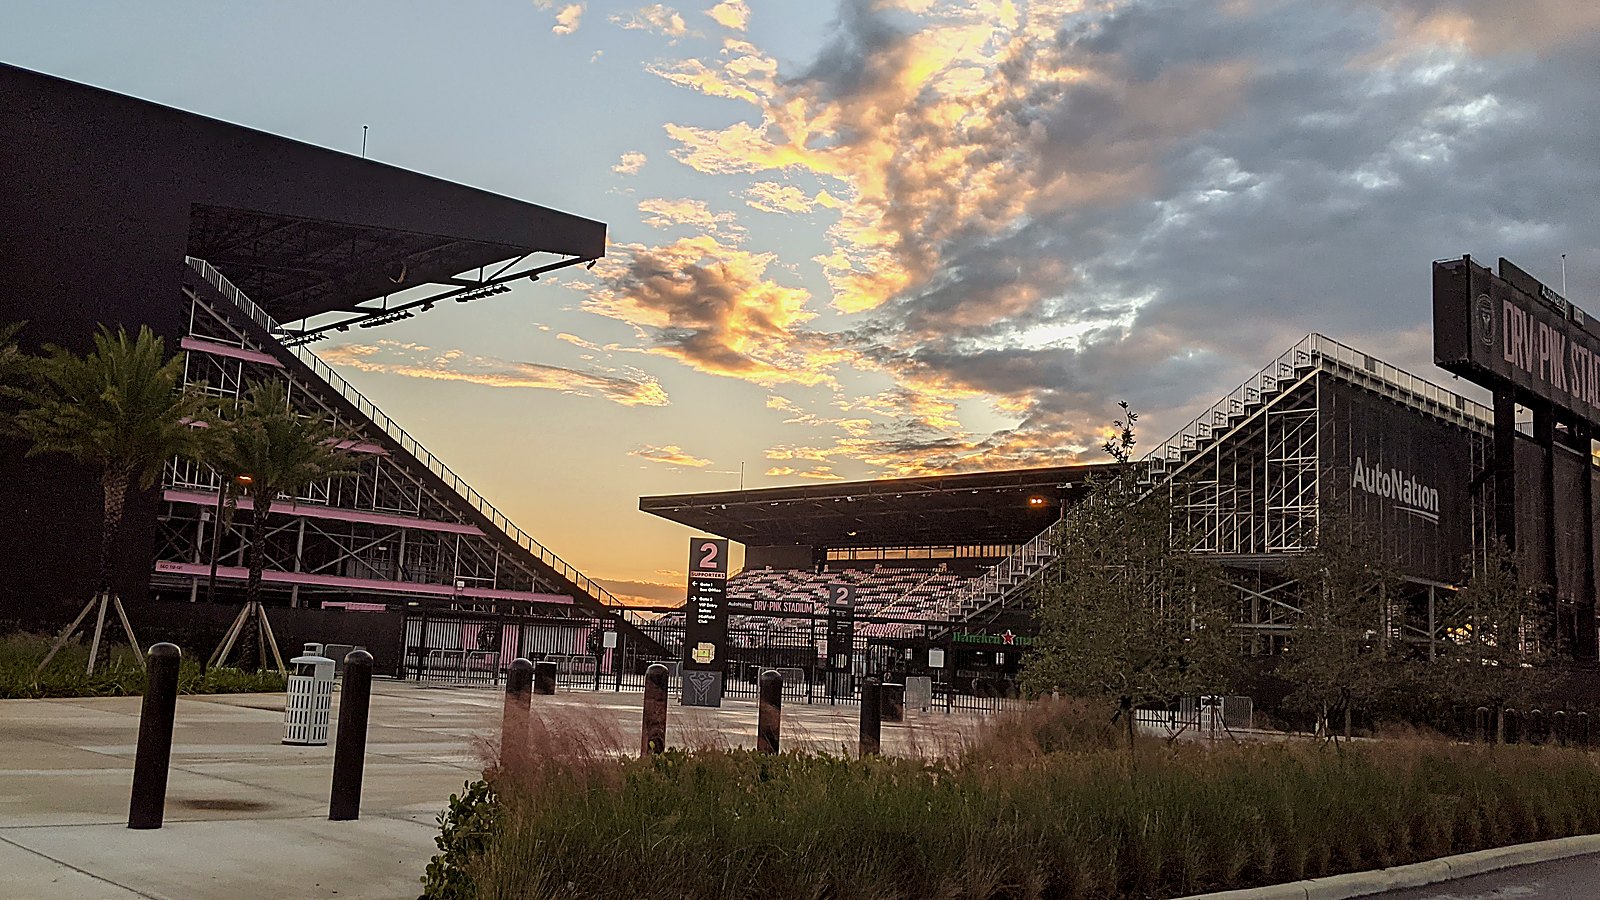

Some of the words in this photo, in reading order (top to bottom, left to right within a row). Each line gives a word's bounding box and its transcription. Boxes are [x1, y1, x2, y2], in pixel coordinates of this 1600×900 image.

[1353, 457, 1439, 512] AutoNation
[699, 542, 718, 569] 2
[835, 587, 848, 605] 2
[727, 601, 752, 609] AutoNation
[783, 602, 813, 614] STADIUM
[952, 631, 1001, 645] Heineken
